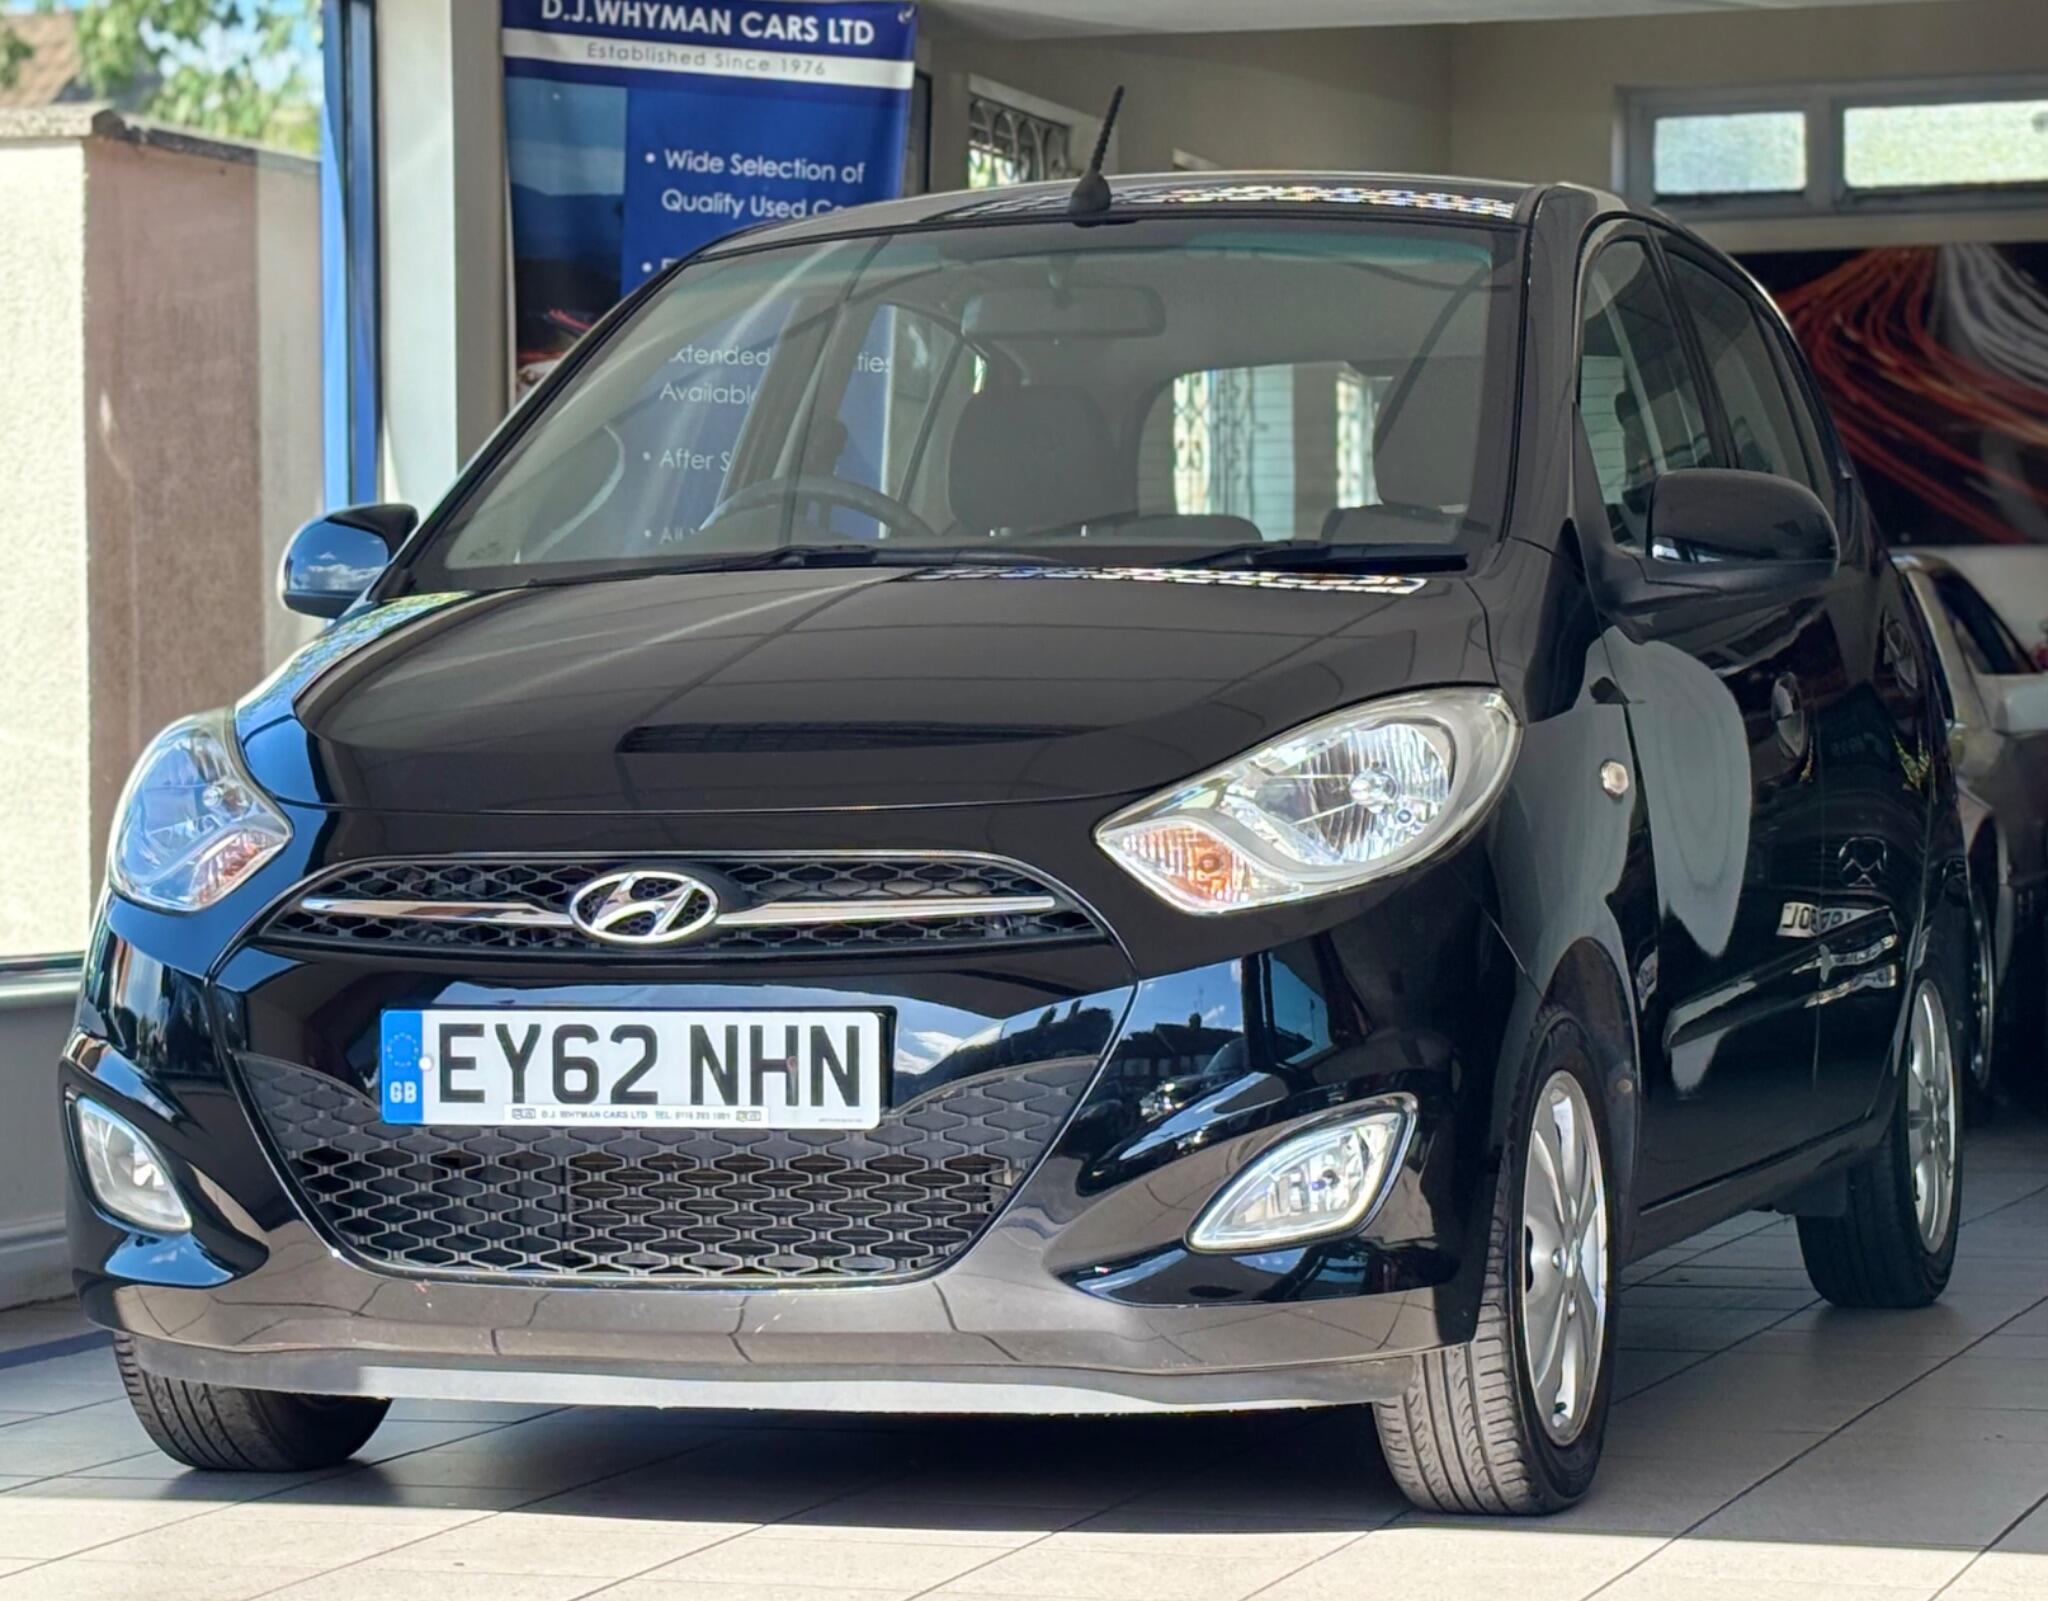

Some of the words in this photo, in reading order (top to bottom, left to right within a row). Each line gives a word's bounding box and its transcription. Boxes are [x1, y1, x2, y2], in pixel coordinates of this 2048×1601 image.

[740, 12, 818, 42] CARS
[828, 19, 875, 45] LTD
[587, 43, 706, 66] Established
[714, 52, 771, 72] Since
[780, 57, 827, 76] 1976
[665, 149, 724, 174] Wide
[730, 153, 836, 182] Selection
[841, 162, 865, 184] of
[661, 188, 745, 219] Quality
[751, 195, 806, 218] Used
[669, 344, 771, 366] xtended
[659, 449, 713, 470] After
[439, 1023, 658, 1104] EY62
[690, 1025, 860, 1106] NHN
[389, 1081, 417, 1103] GB
